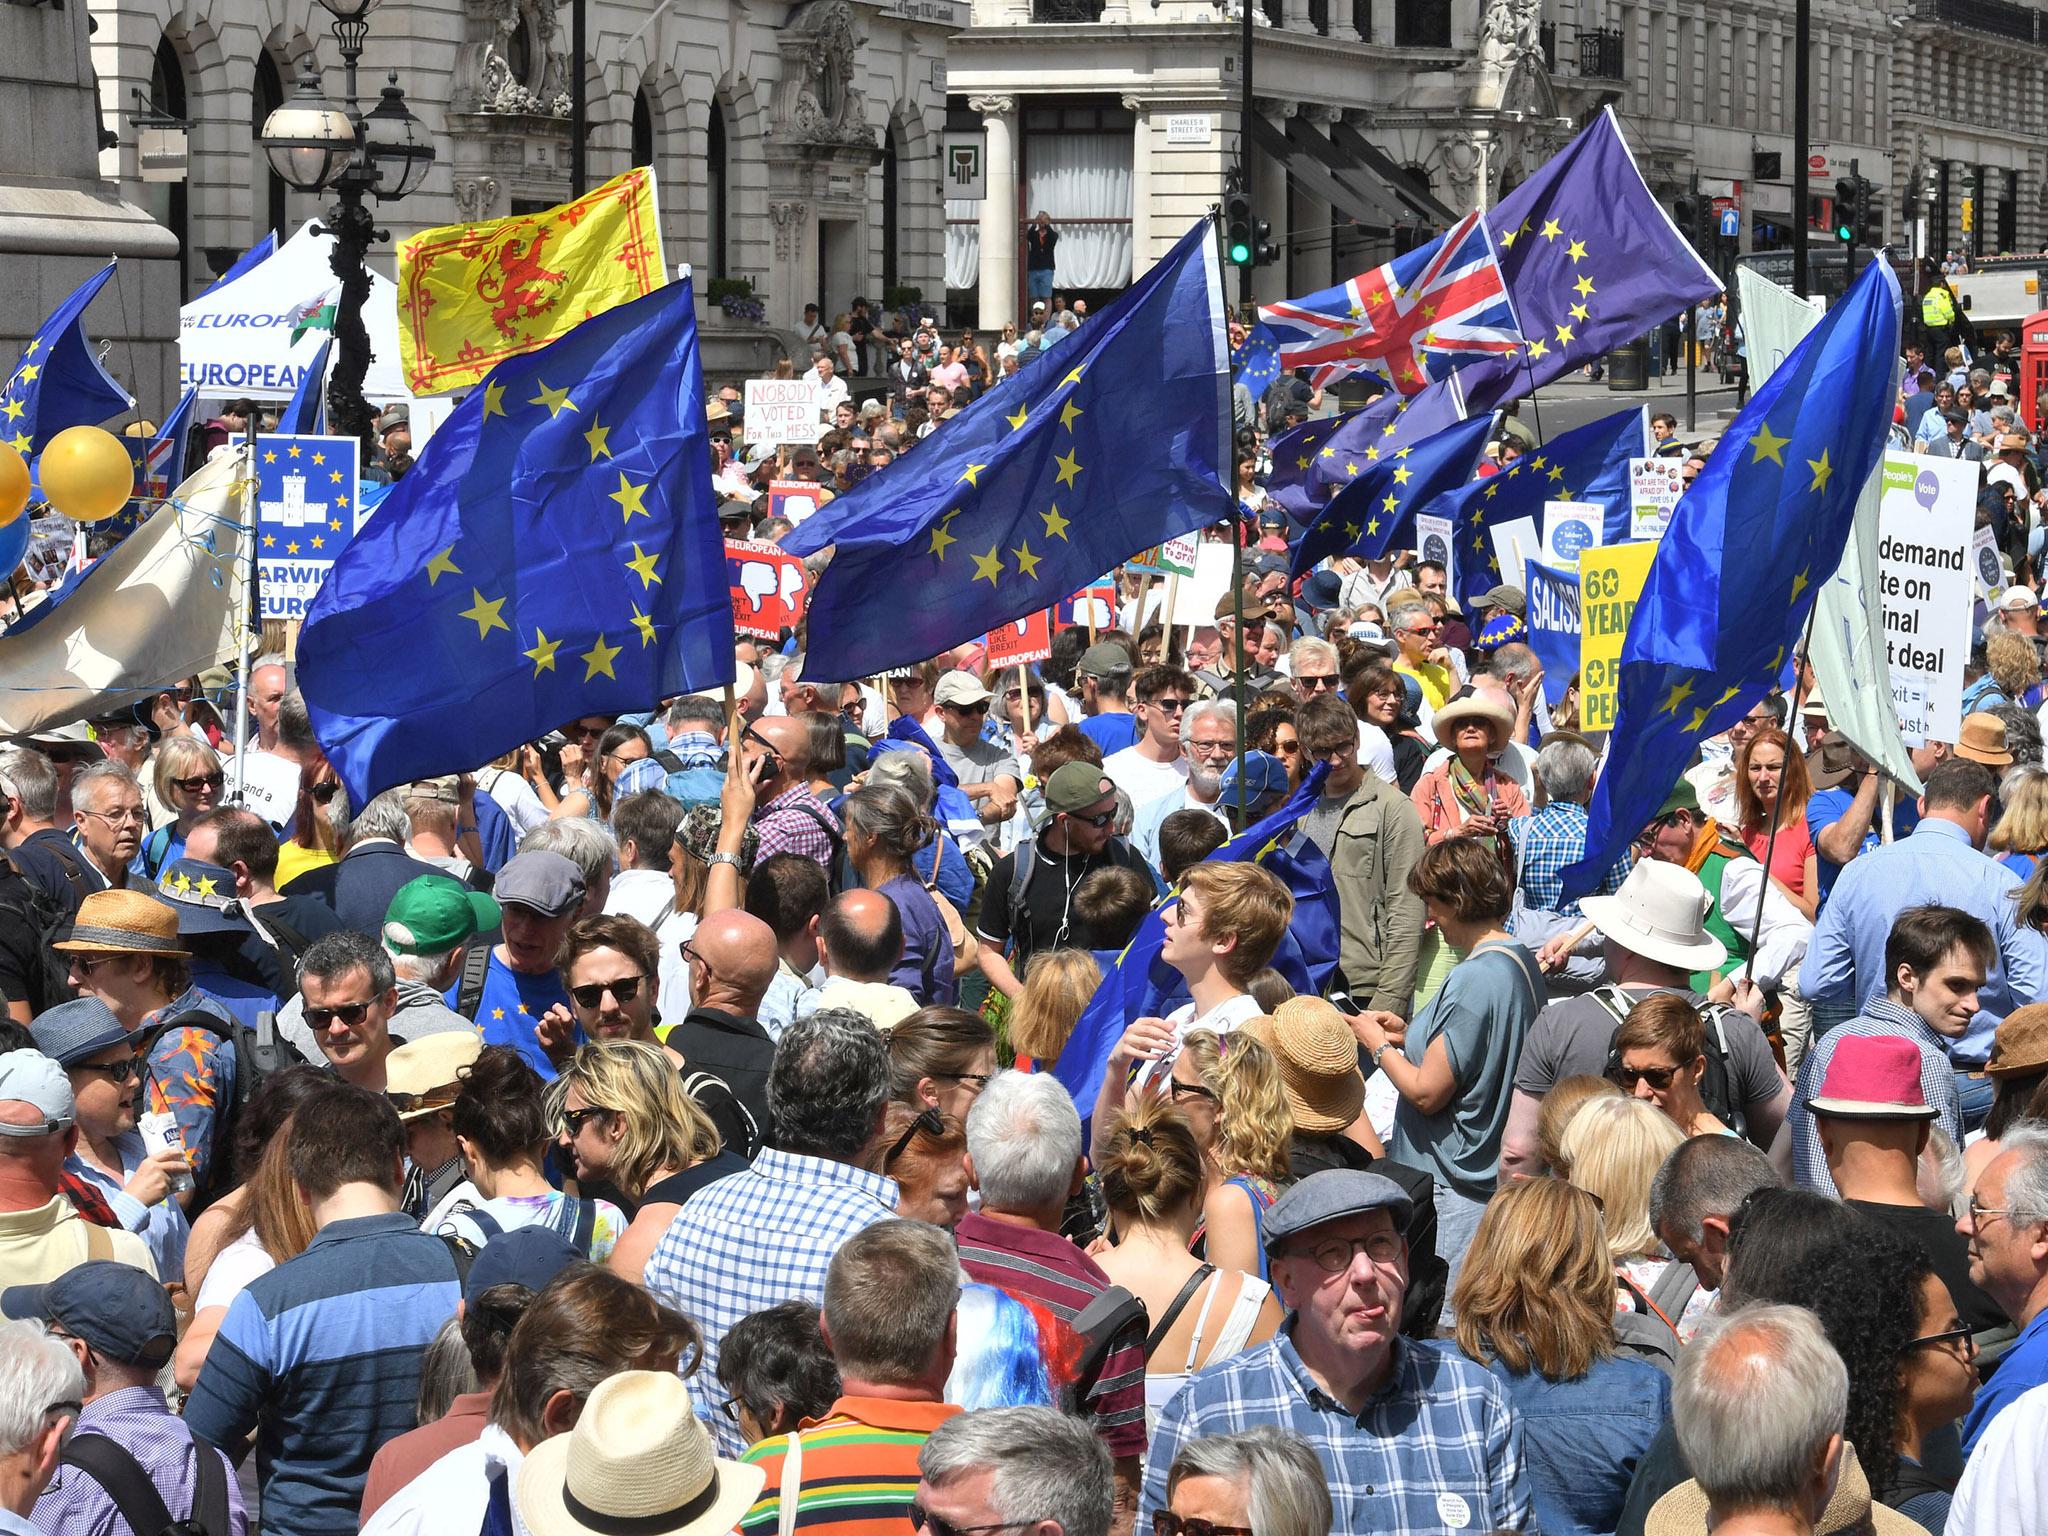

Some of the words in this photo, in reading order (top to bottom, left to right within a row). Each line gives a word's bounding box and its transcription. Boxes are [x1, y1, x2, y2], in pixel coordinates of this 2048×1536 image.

[1171, 126, 1193, 134] STREET
[752, 384, 817, 402] NOBODY
[761, 406, 805, 421] VOTED
[787, 424, 816, 438] MESS
[780, 480, 820, 489] EUROPEAN
[1918, 483, 1937, 495] Vote
[734, 542, 781, 557] EUROPEAN
[1879, 535, 1965, 571] demand
[1175, 551, 1195, 564] STAY
[1585, 568, 1619, 599] 60
[1904, 579, 1931, 600] on
[989, 634, 1007, 645] LIKE
[990, 640, 1018, 653] BREXIT
[1000, 648, 1049, 667] EUROPEAN
[1898, 643, 1944, 673] deal
